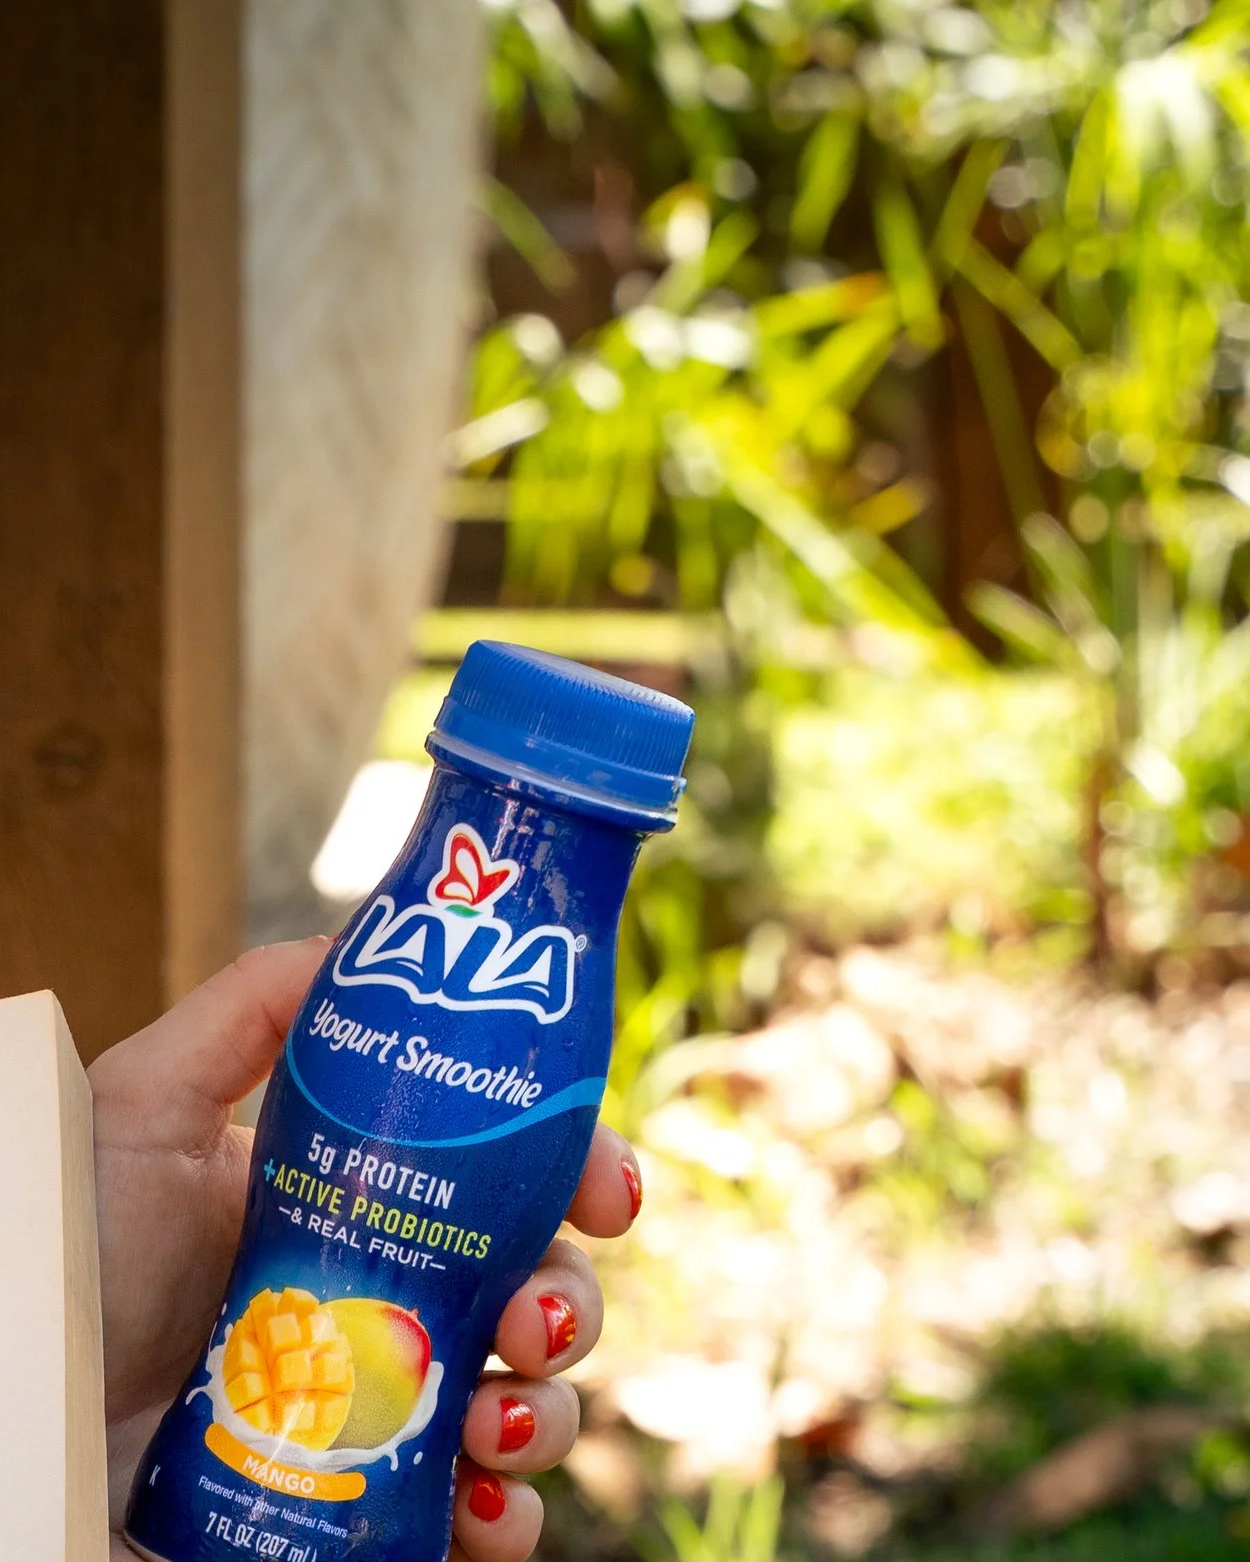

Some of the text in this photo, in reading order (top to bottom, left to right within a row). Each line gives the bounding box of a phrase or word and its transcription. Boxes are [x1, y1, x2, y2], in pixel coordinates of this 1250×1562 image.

[333, 896, 575, 1024] LALA
[309, 998, 542, 1108] Yogurt Smoothie
[308, 1133, 456, 1210] 5g PROTEIN
[308, 1214, 361, 1248] REAL
[351, 1196, 492, 1259] PROBIOTICS
[243, 1455, 315, 1494] MANGO
[198, 1475, 348, 1539] Flavored with other Natural Flavors
[205, 1512, 215, 1533] 7
[216, 1516, 232, 1541] FL
[234, 1524, 256, 1549] OZ
[256, 1531, 289, 1561] (207
